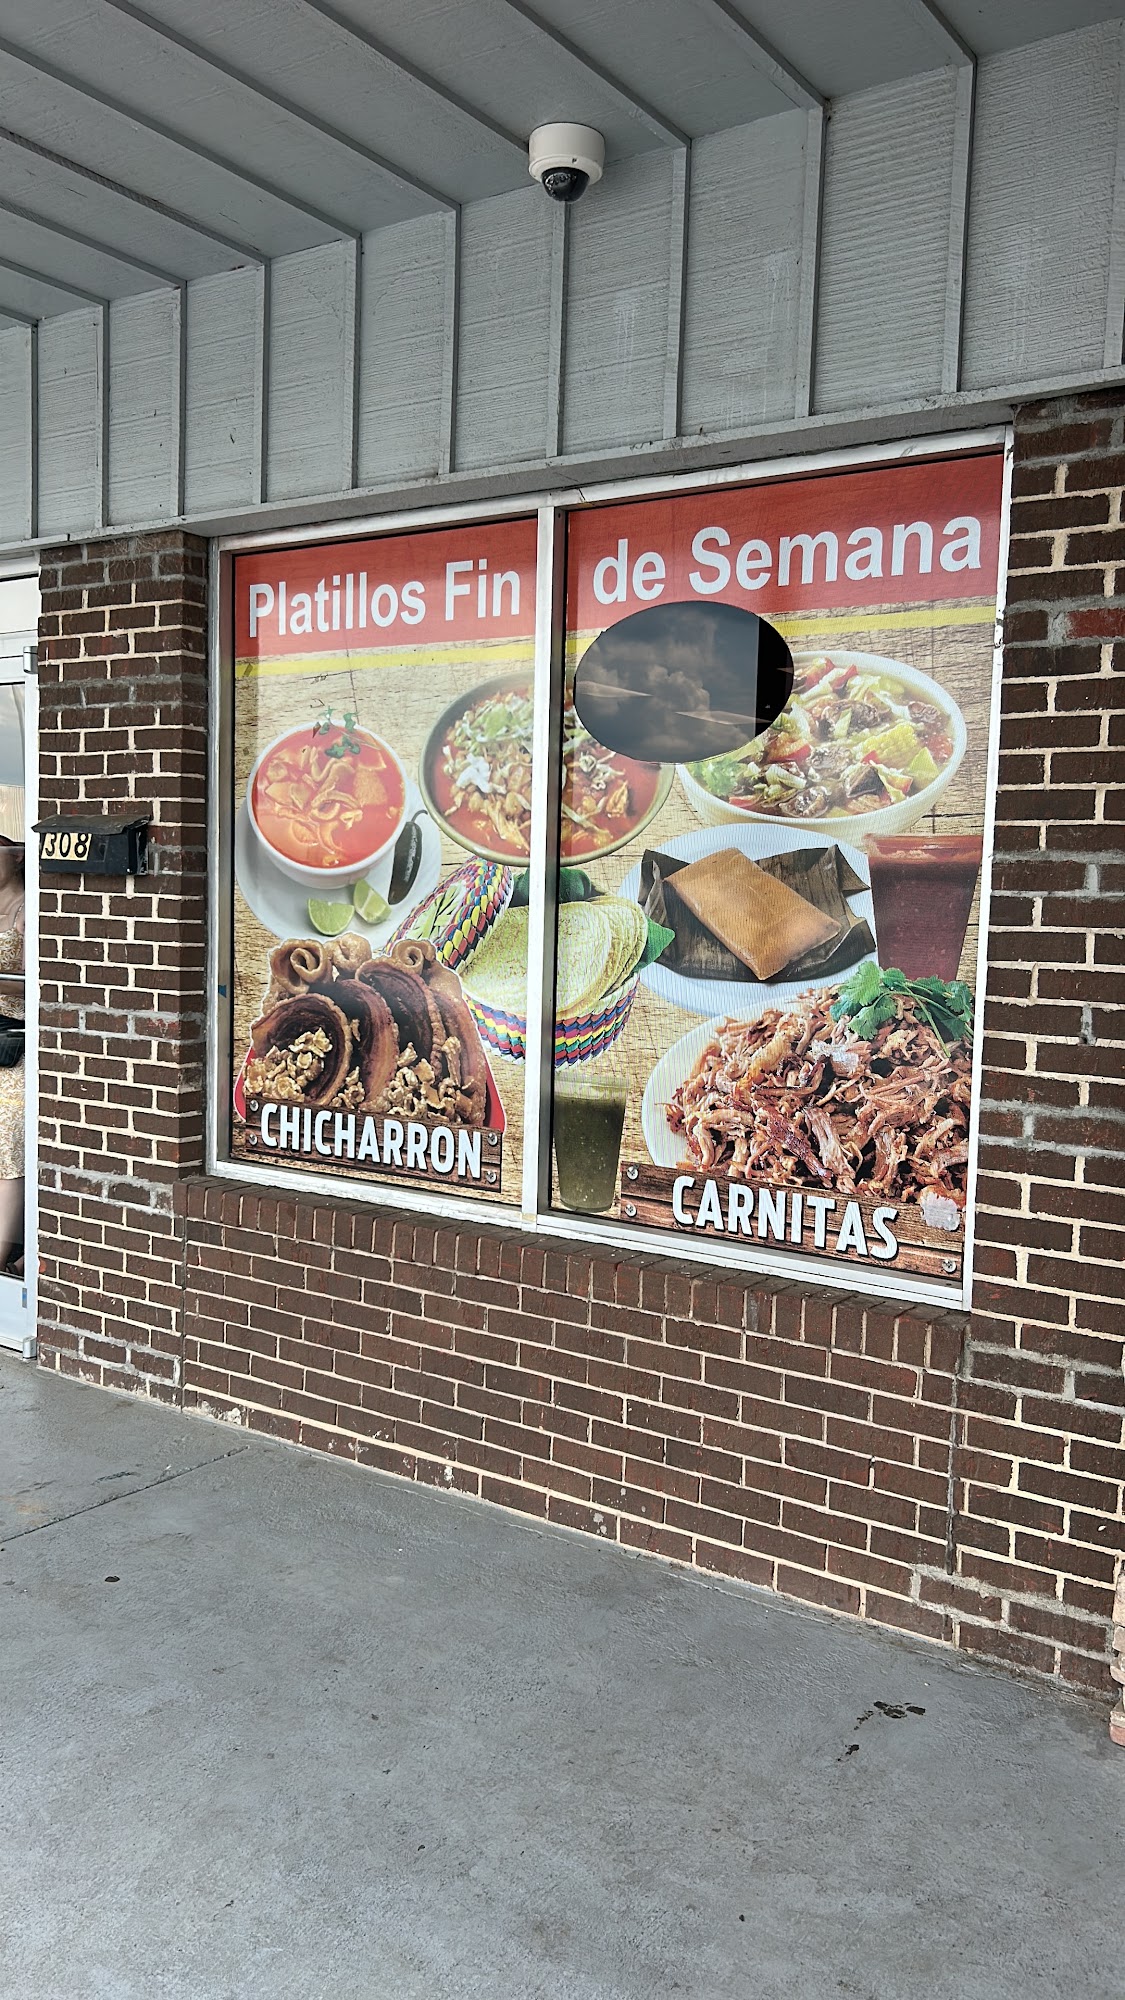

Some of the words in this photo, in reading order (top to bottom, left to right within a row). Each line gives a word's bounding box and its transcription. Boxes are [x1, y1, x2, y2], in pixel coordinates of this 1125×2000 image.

[249, 572, 426, 637] Platillos
[445, 558, 520, 621] Fin
[592, 539, 666, 604] de
[689, 515, 982, 594] Semana
[45, 832, 88, 858] 308
[260, 1102, 482, 1180] CHICHARRON
[672, 1175, 899, 1260] CARNITAS
